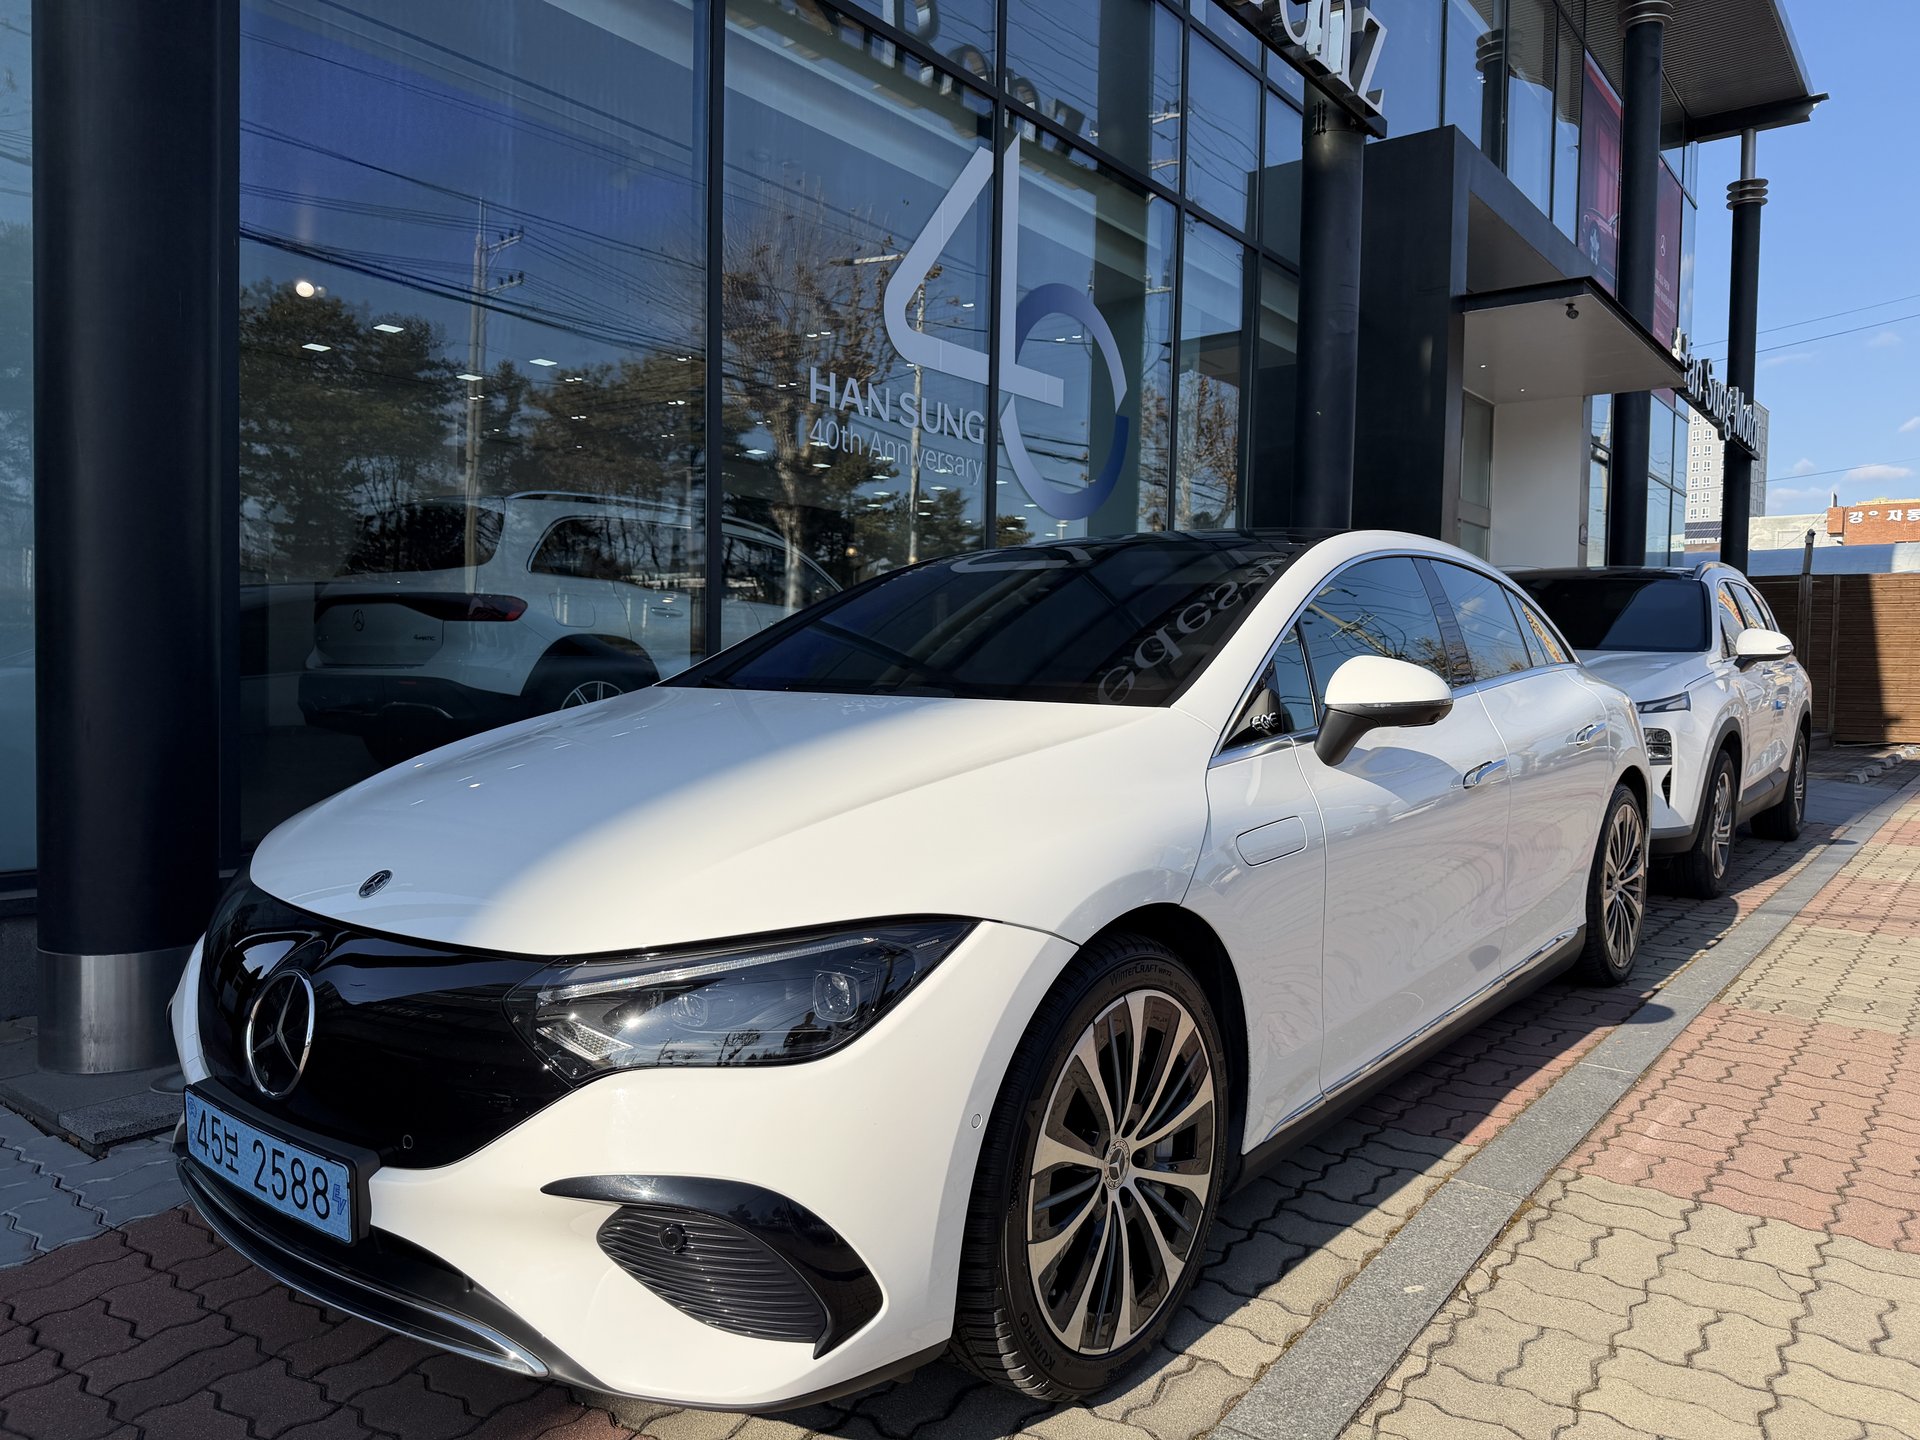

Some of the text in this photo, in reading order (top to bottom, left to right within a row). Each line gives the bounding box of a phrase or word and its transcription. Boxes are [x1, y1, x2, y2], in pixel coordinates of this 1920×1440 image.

[810, 366, 985, 445] HAN SUNG
[1672, 327, 1703, 402] Han
[1704, 358, 1732, 441] Sung
[810, 417, 983, 486] 40th Anniversary
[197, 1109, 331, 1220] 45보 2588
[332, 1183, 347, 1216] EV
